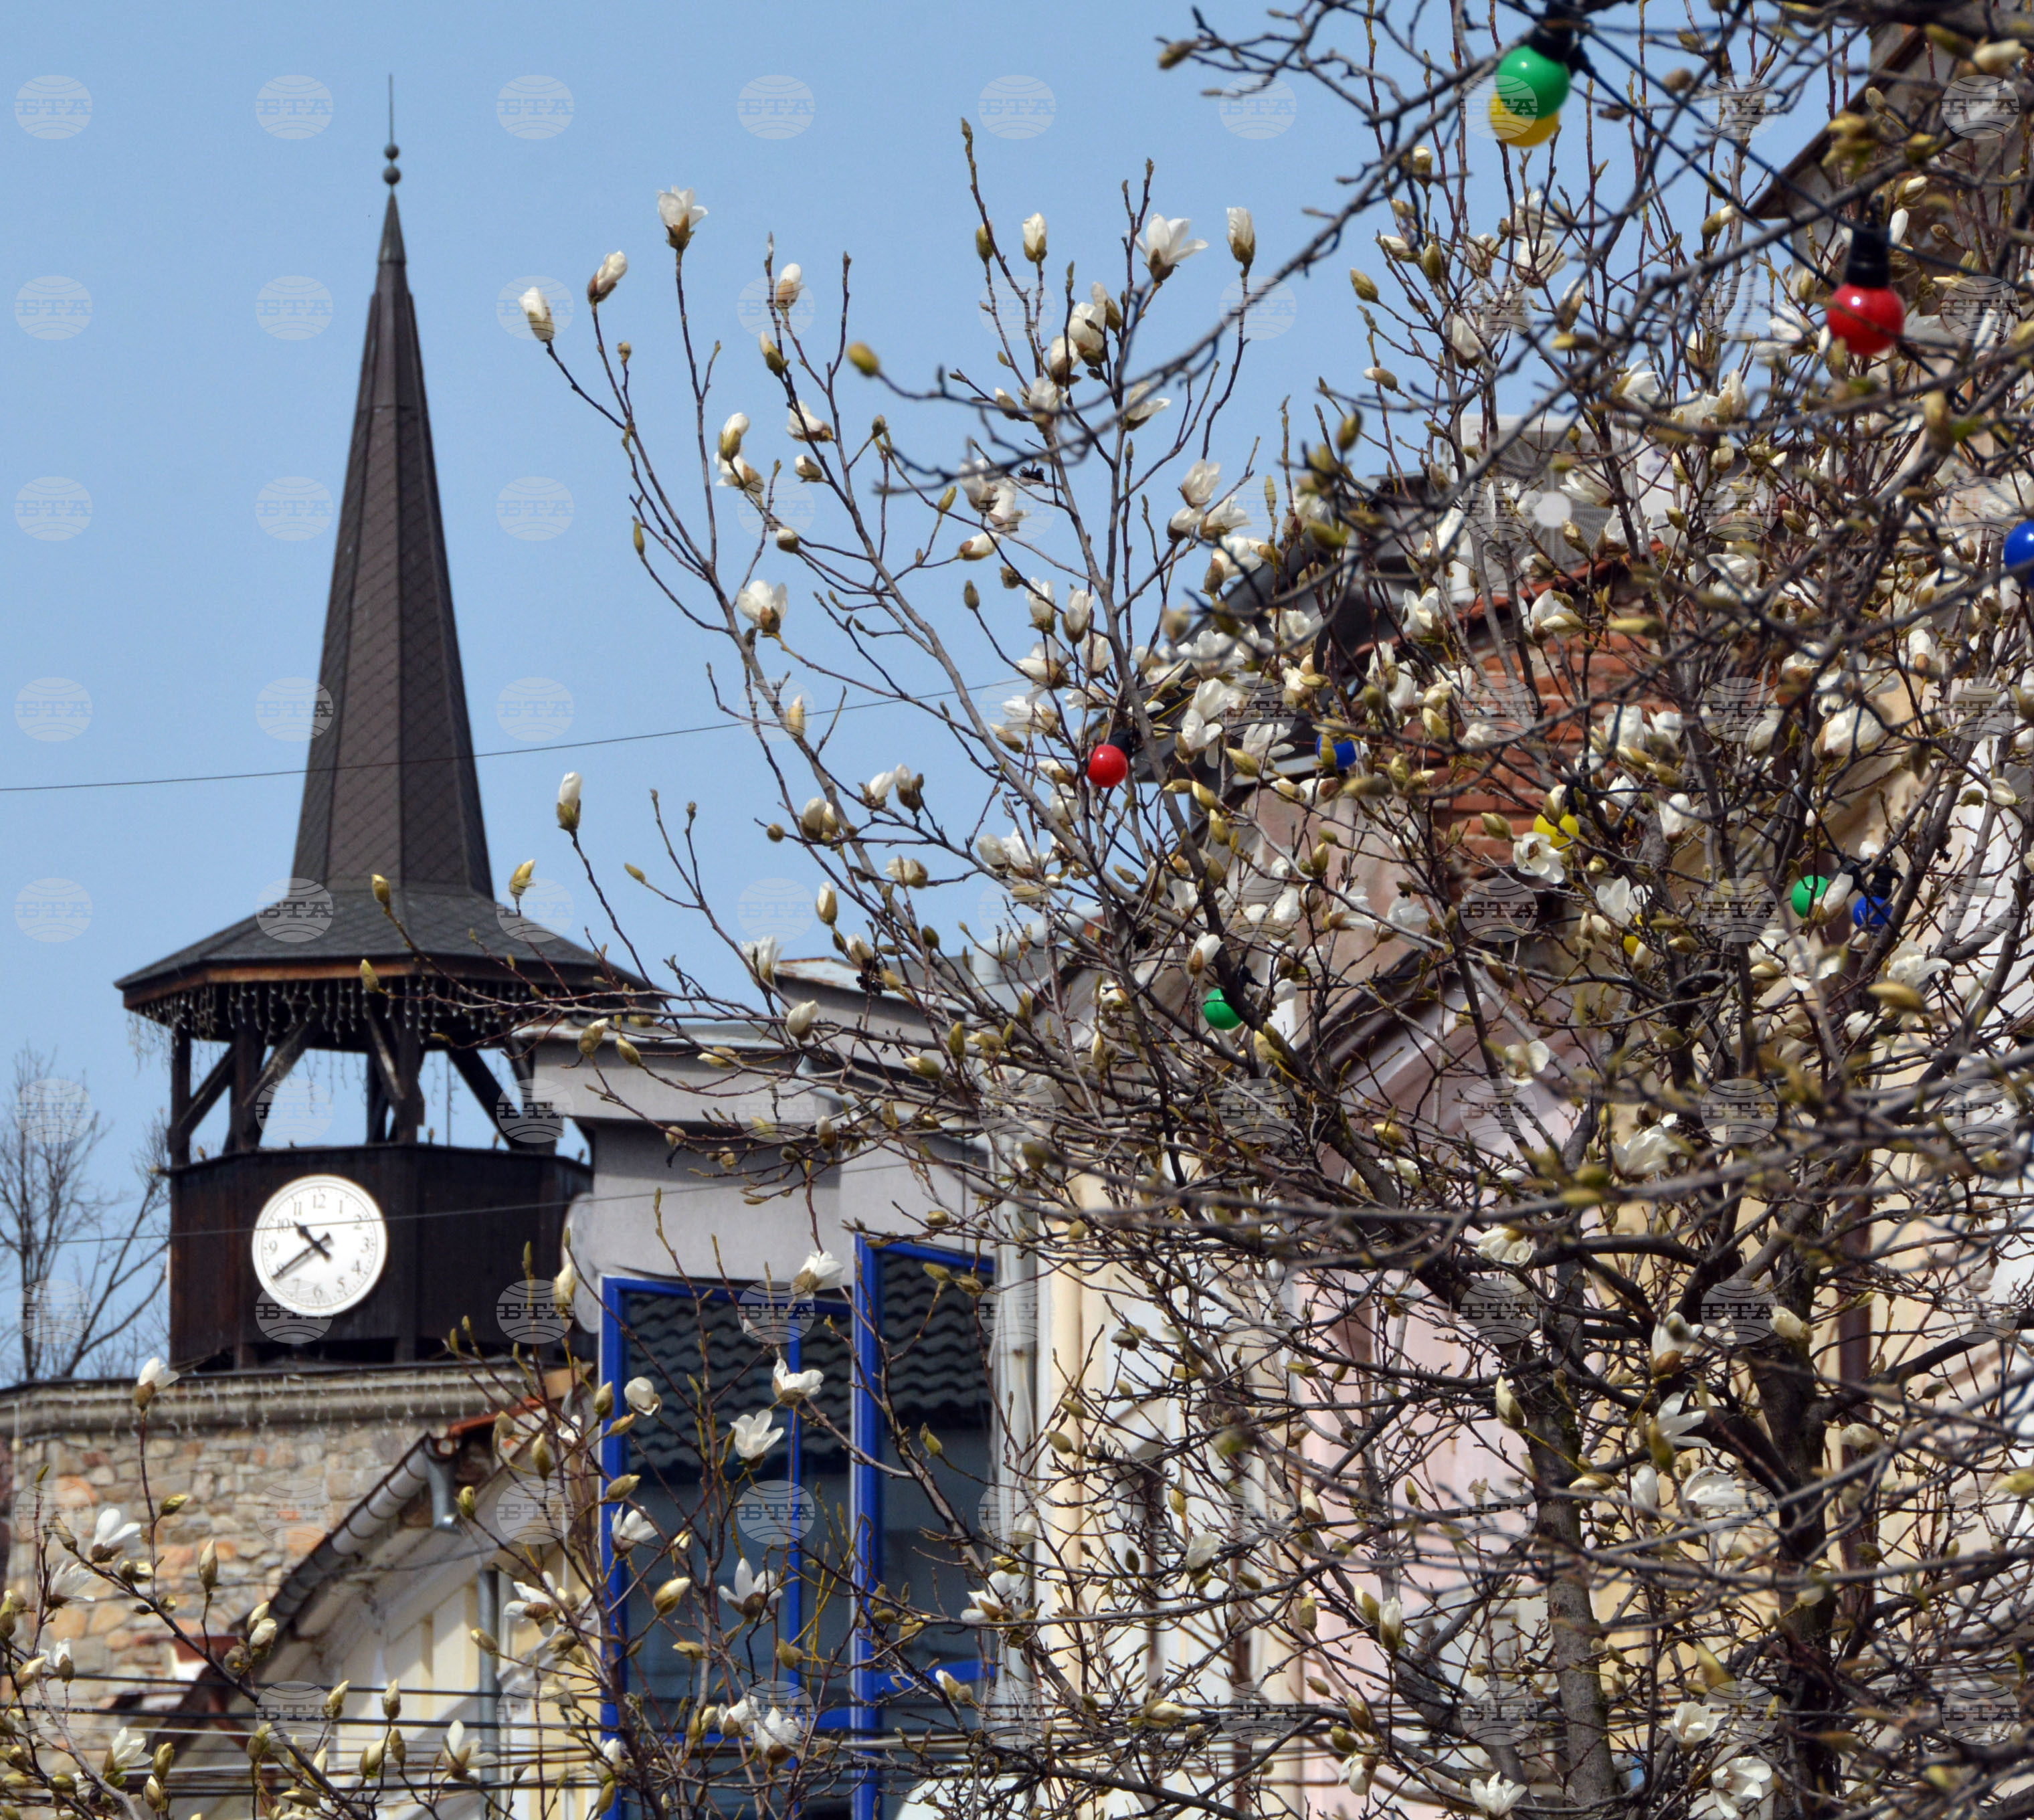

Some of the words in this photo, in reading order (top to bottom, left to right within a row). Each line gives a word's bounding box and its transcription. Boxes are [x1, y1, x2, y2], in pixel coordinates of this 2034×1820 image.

[293, 1200, 303, 1216] 11
[312, 1193, 327, 1209] 12
[339, 1199, 344, 1214] 1
[276, 1217, 290, 1234] 10
[353, 1213, 363, 1231] 2
[268, 1240, 278, 1256] 9
[360, 1237, 371, 1253] 3
[351, 1259, 362, 1275] 4
[313, 1283, 323, 1299] 6
[337, 1276, 346, 1293] 5
